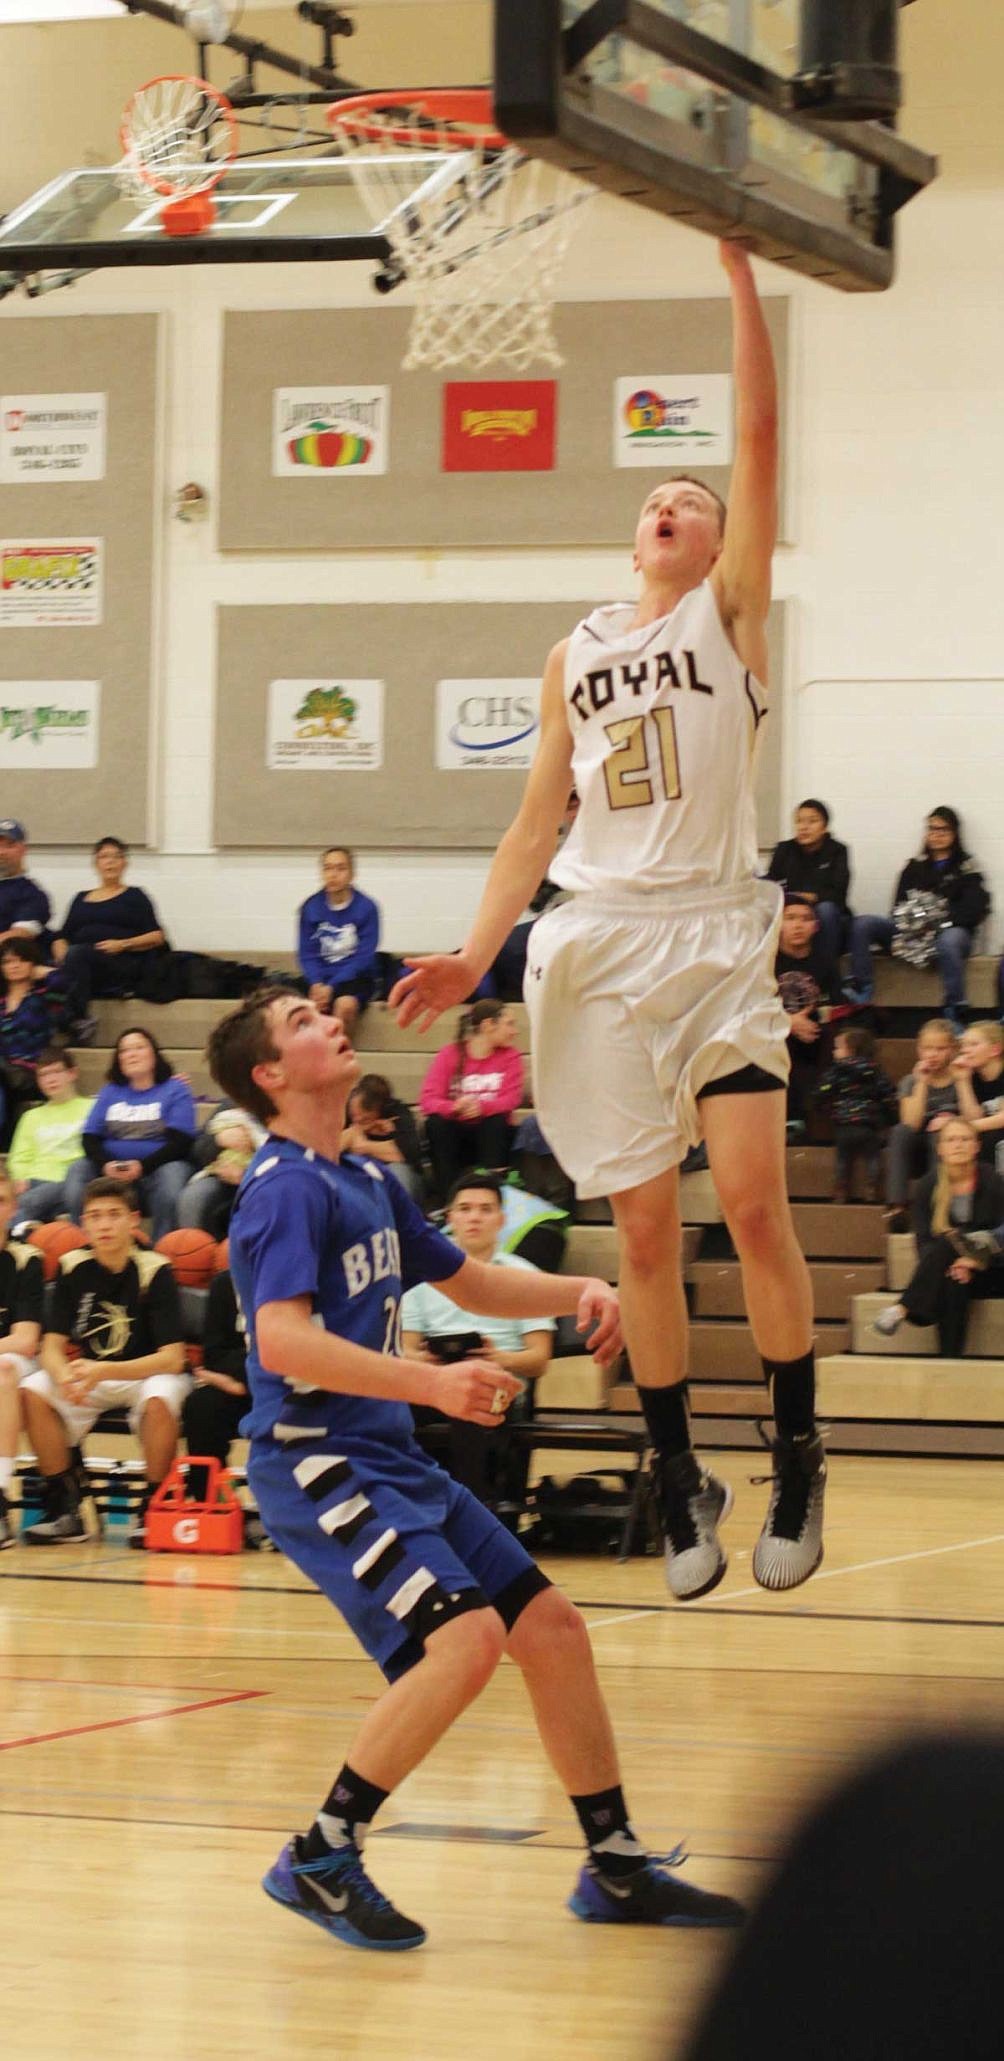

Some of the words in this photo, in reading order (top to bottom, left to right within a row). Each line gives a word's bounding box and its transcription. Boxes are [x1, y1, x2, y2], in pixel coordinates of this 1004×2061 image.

[457, 695, 536, 728] CHS
[603, 705, 683, 811] 21
[173, 1518, 201, 1545] G
